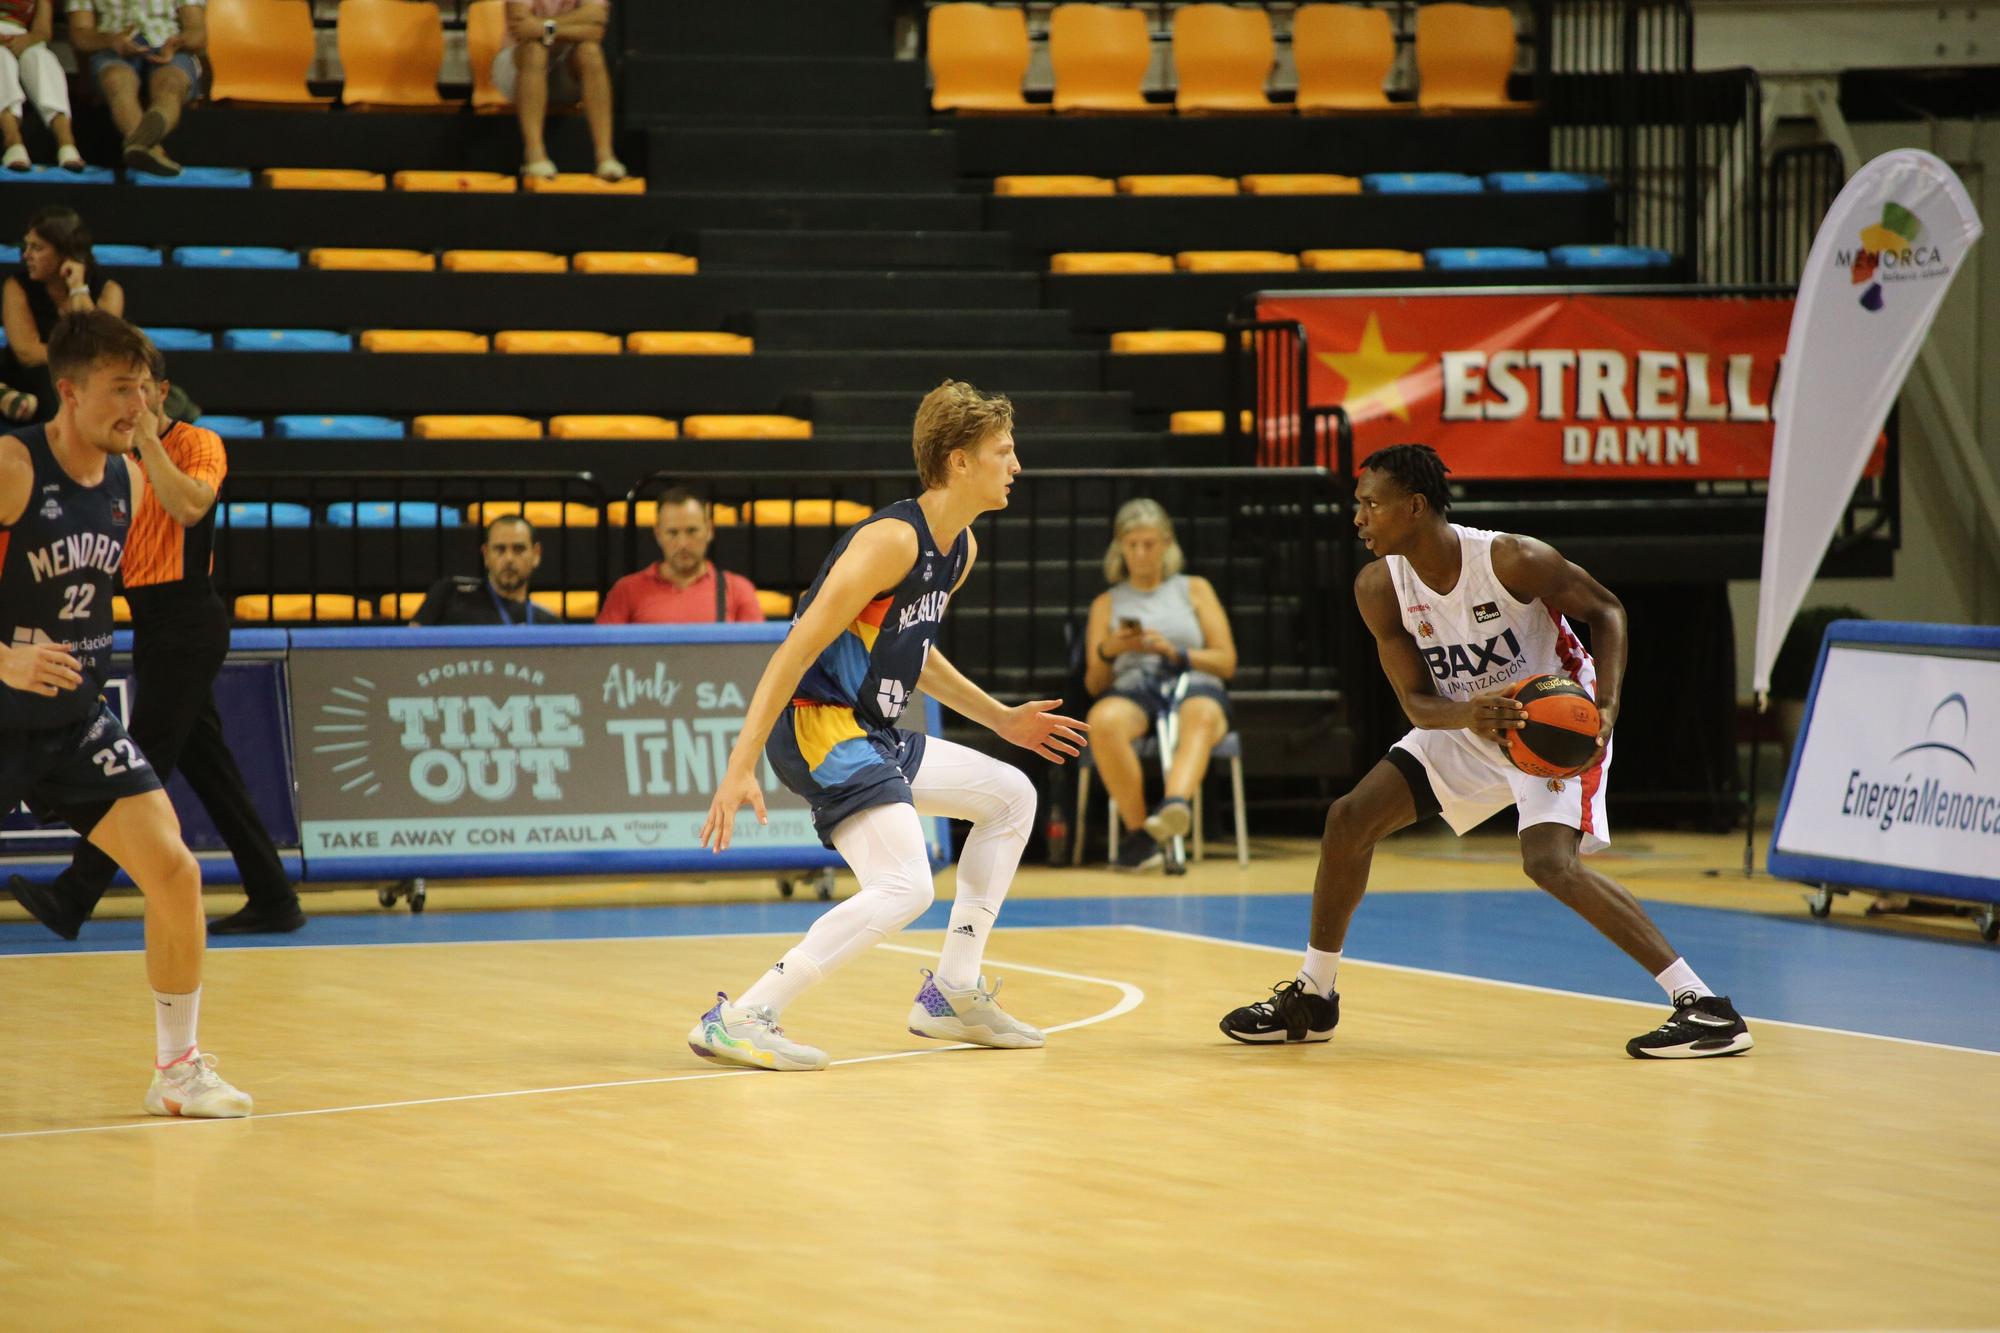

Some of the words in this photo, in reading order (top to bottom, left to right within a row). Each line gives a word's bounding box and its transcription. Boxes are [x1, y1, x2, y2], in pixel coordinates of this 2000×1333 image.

[1835, 246, 1941, 269] MENORCA
[1563, 426, 1700, 465] DAMM
[27, 532, 124, 583] MENORC
[58, 583, 96, 620] 22
[417, 659, 495, 687] SPORTS
[504, 662, 546, 687] BAR
[1420, 627, 1521, 680] BAXI
[695, 681, 747, 710] SA
[387, 693, 585, 750] TIME
[92, 738, 146, 777] 22
[408, 748, 571, 805] OUT
[1841, 768, 2000, 835] EnergíaMenorca
[319, 830, 380, 849] TAKE
[390, 829, 456, 848] AWAY
[466, 827, 515, 845] CON
[526, 825, 617, 845] ATAULA
